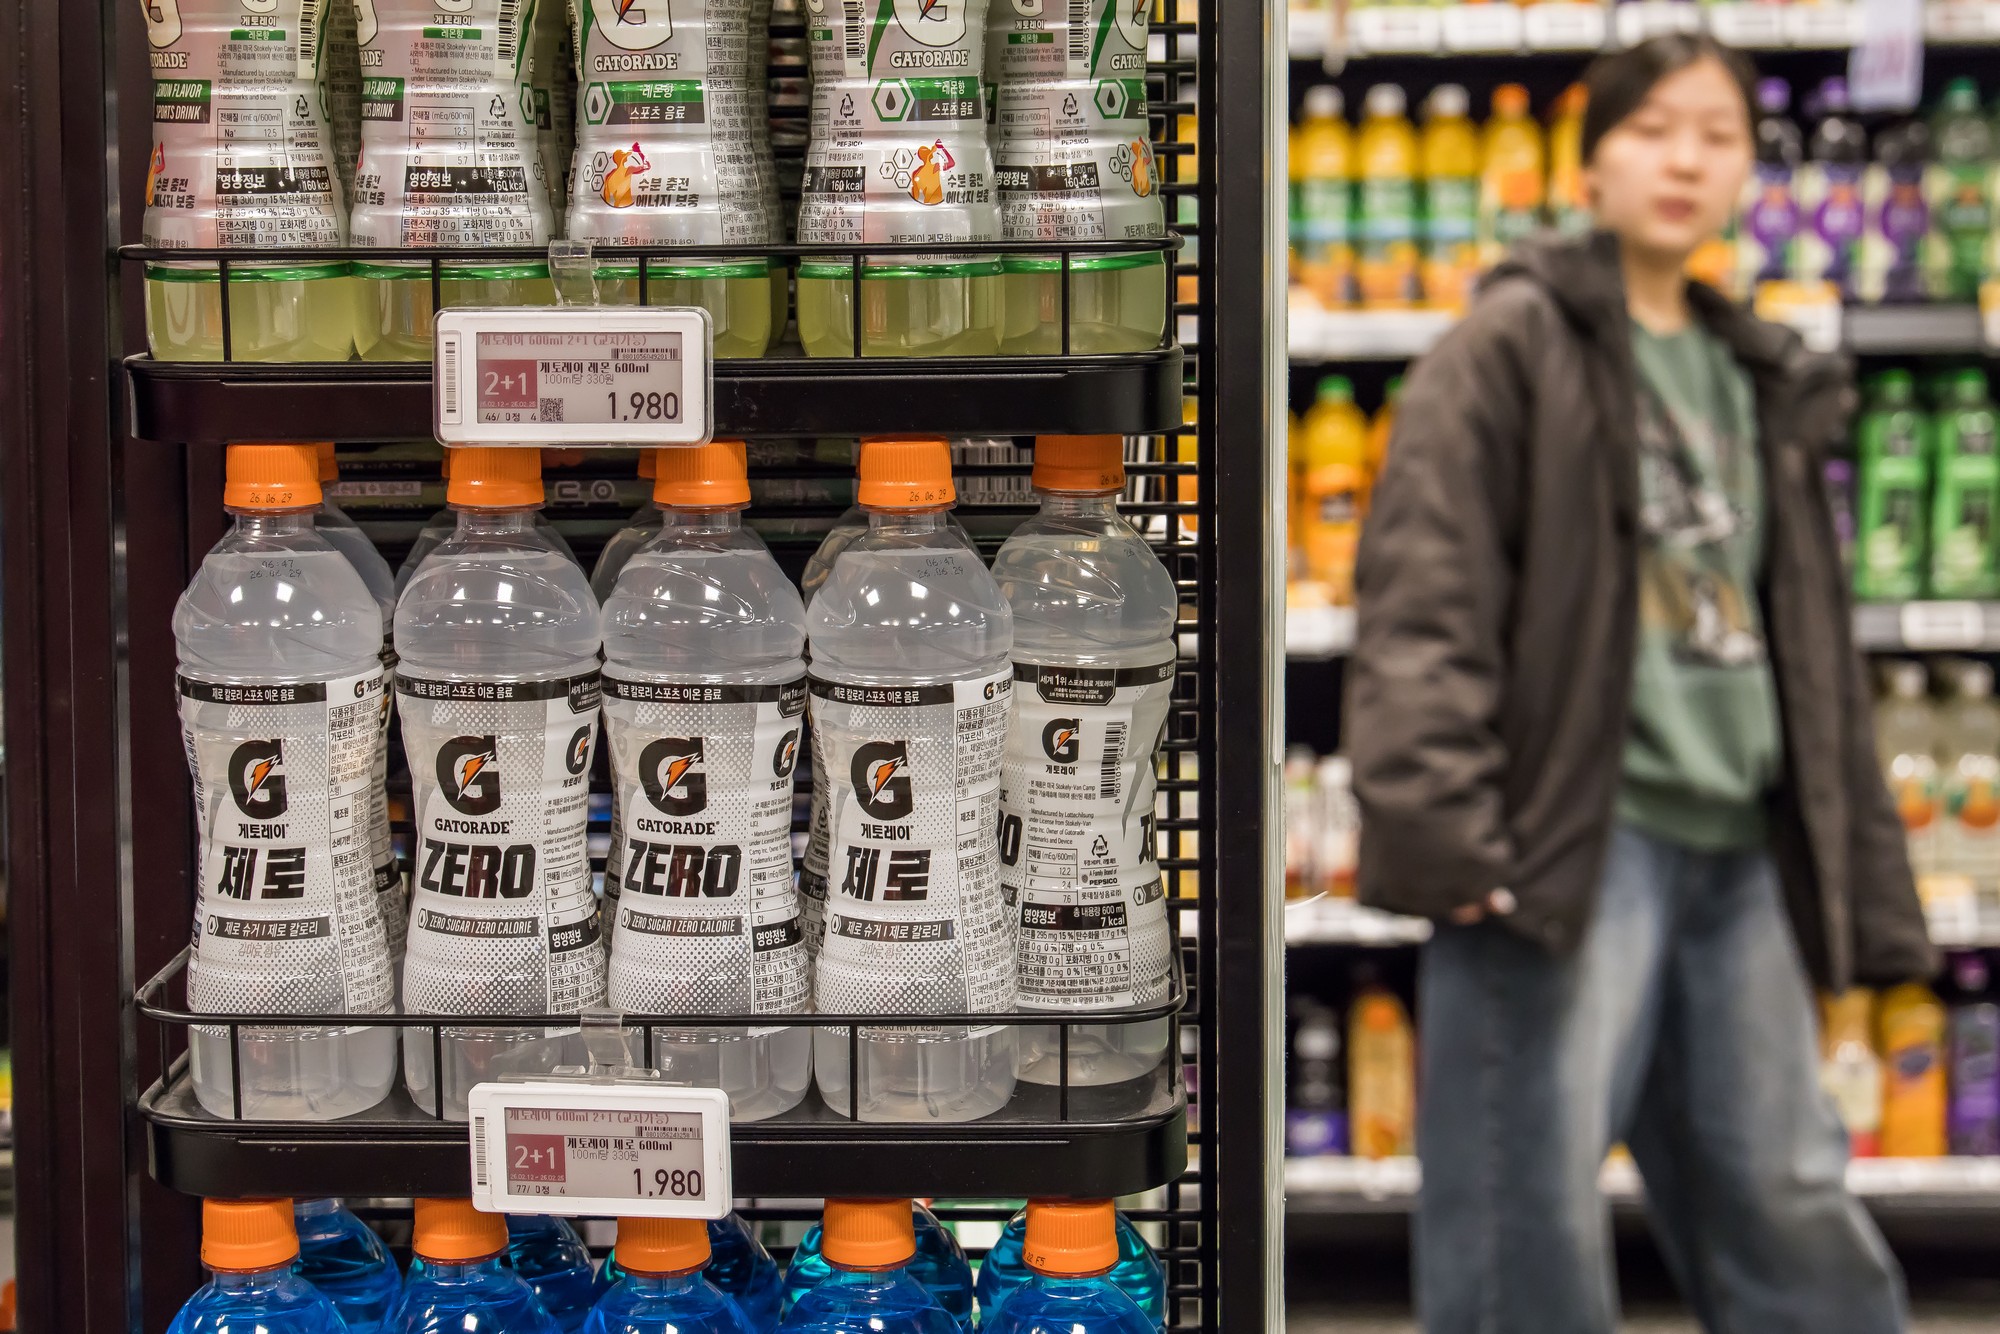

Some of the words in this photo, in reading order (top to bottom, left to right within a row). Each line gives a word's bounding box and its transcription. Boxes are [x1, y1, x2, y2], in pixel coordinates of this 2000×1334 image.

[240, 16, 277, 27] 게토레이
[434, 14, 472, 26] 게토레이
[248, 30, 270, 40] 레몬향
[594, 53, 678, 72] GATORADE
[890, 50, 968, 69] GATORADE
[172, 84, 203, 98] FLAVOR
[370, 81, 396, 96] FLAVOR
[642, 83, 674, 98] 레몬향
[940, 80, 965, 96] 레몬향
[174, 104, 201, 120] DRINK
[372, 103, 394, 118] DRINK
[630, 105, 662, 120] 스포츠
[664, 106, 686, 120] 음료
[931, 102, 958, 117] 스포츠
[960, 102, 974, 116] 음료
[318, 180, 330, 191] kcal
[409, 172, 452, 188] 영양정보
[510, 180, 525, 191] kcal
[638, 177, 662, 191] 수분
[666, 176, 690, 191] 충전
[845, 180, 864, 192] kcal
[948, 172, 966, 188] 수분
[968, 172, 984, 188] 충전
[636, 194, 672, 208] 에너지
[675, 194, 700, 208] 보충
[945, 190, 974, 204] 에너지
[976, 188, 990, 205] 보충
[279, 218, 308, 230] 포화지방
[404, 218, 441, 230] 트랜스지방
[462, 218, 494, 229] 포화지방
[1036, 214, 1065, 225] 포화지방
[529, 334, 562, 346] 600ml
[568, 335, 588, 346] 2+1
[540, 361, 584, 374] 게토레이
[588, 361, 610, 374] 레몬
[614, 362, 649, 374] 600ml
[484, 371, 528, 396] 2+1
[544, 374, 583, 385] 100ml당
[586, 374, 614, 386] 330원
[608, 391, 679, 422] 1,980
[530, 412, 537, 421] 4
[212, 686, 223, 699] 제로
[224, 688, 243, 702] 칼로리
[244, 688, 264, 701] 스포츠
[264, 688, 279, 702] 이온
[280, 688, 296, 701] 음료
[414, 682, 428, 696] 제로
[428, 682, 450, 698] 칼로리
[452, 685, 476, 698] 스포츠
[478, 684, 494, 699] 이온
[496, 685, 514, 698] 음료
[616, 684, 630, 698] 제로
[630, 684, 653, 700] 칼로리
[654, 688, 681, 700] 스포츠
[682, 688, 701, 701] 이온
[703, 688, 722, 700] 음료
[834, 686, 846, 700] 제로
[846, 688, 865, 702] 칼로리
[865, 690, 886, 703] 스포츠
[887, 690, 902, 704] 이온
[904, 690, 920, 703] 음료
[1045, 764, 1076, 776] 게토레이
[238, 822, 286, 840] 게토레이
[434, 817, 511, 835] GATORADE
[636, 818, 716, 836] GATORADE
[860, 822, 911, 841] 게토레이
[217, 845, 307, 901] 제로
[420, 836, 537, 900] ZERO
[624, 837, 742, 898] ZERO
[841, 844, 932, 902] 제로
[1089, 878, 1118, 886] PEPSICO
[1024, 908, 1056, 925] 영양정보
[1073, 906, 1080, 918] 총
[1081, 906, 1100, 918] 내용량
[1102, 906, 1115, 915] 600
[1116, 904, 1124, 914] ml
[224, 920, 240, 934] 제로
[242, 922, 260, 936] 슈거
[267, 922, 287, 937] 제로
[289, 920, 319, 936] 칼로리
[429, 914, 446, 928] ZERO
[446, 918, 470, 934] SUGAR
[474, 920, 496, 936] ZERO
[496, 920, 532, 936] CALORIE
[631, 914, 647, 930] ZERO
[646, 918, 671, 933] SUGAR
[676, 919, 698, 934] ZERO
[699, 918, 736, 934] CALORIE
[1100, 916, 1106, 927] 7
[1108, 915, 1126, 926] kcal
[552, 928, 583, 949] 영양정보
[756, 927, 788, 947] 영양정보
[846, 924, 862, 937] 제로
[864, 924, 882, 939] 슈거
[888, 924, 910, 940] 제로
[911, 924, 942, 940] 칼로리
[1059, 931, 1066, 940] 15
[1076, 930, 1100, 941] 탄수화물
[1061, 942, 1074, 953] 지방
[1018, 951, 1048, 966] 트랜스지방
[1065, 954, 1092, 965] 포화지방
[1083, 965, 1103, 976] 단백질
[510, 1108, 550, 1122] 게토레이
[556, 1110, 589, 1122] 600ml
[592, 1112, 613, 1124] 2+1
[568, 1136, 609, 1150] 게토레이
[614, 1138, 635, 1151] 제로
[639, 1140, 673, 1152] 600ml
[514, 1145, 557, 1170] 2+1
[572, 1149, 608, 1161] 100ml당
[612, 1150, 639, 1162] 330원
[633, 1167, 702, 1197] 1,980
[559, 1186, 566, 1194] 4
